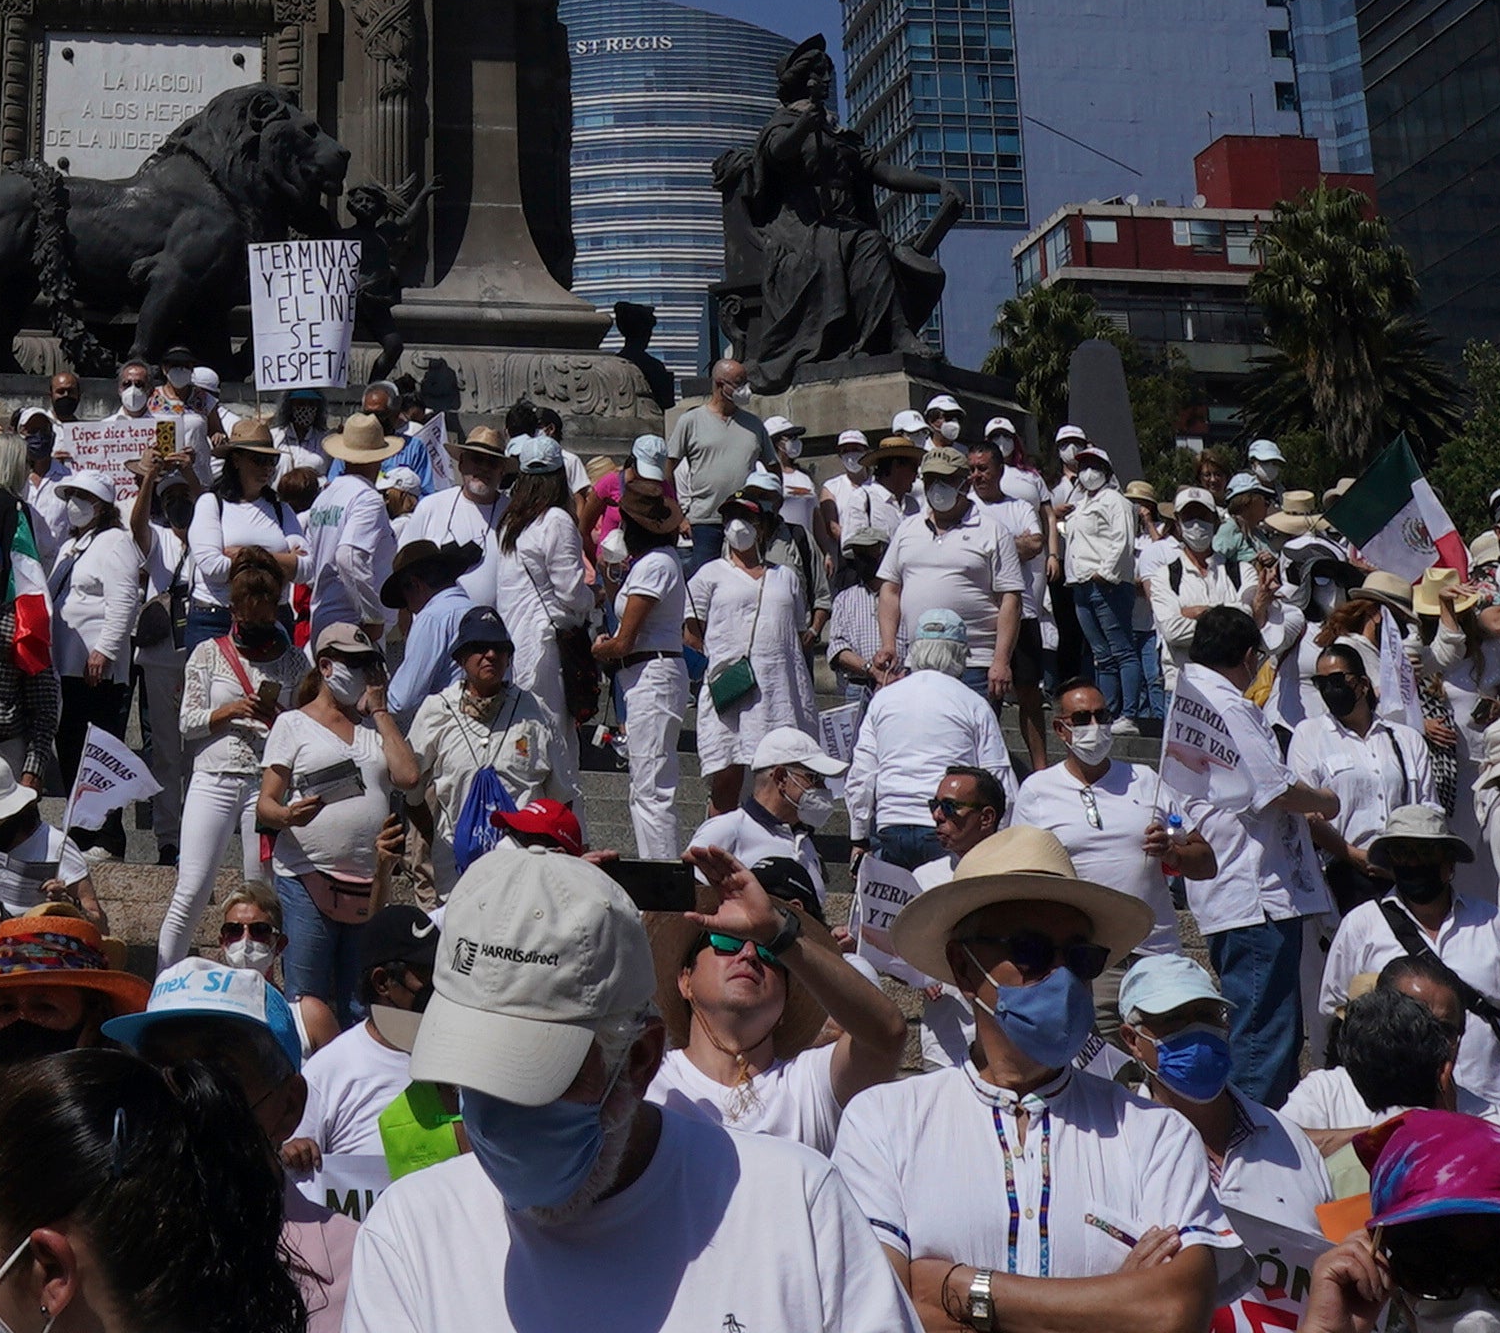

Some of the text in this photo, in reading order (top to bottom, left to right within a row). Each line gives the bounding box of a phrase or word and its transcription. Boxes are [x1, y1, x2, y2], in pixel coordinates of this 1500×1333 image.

[605, 35, 673, 51] REGIS
[103, 72, 203, 93] LA NACION
[81, 100, 94, 119] A
[100, 102, 139, 120] LOS
[46, 129, 71, 147] DE
[77, 130, 102, 148] LA
[253, 241, 360, 271] TERMINAS
[262, 268, 358, 298] Y TE VAS
[278, 295, 356, 323] EL INE
[290, 322, 323, 349] SE
[262, 350, 346, 384] RESPETA
[76, 442, 99, 455] tres
[1175, 722, 1241, 767] Y TE VAS!
[868, 908, 879, 924] Y
[326, 1189, 384, 1222] MI
